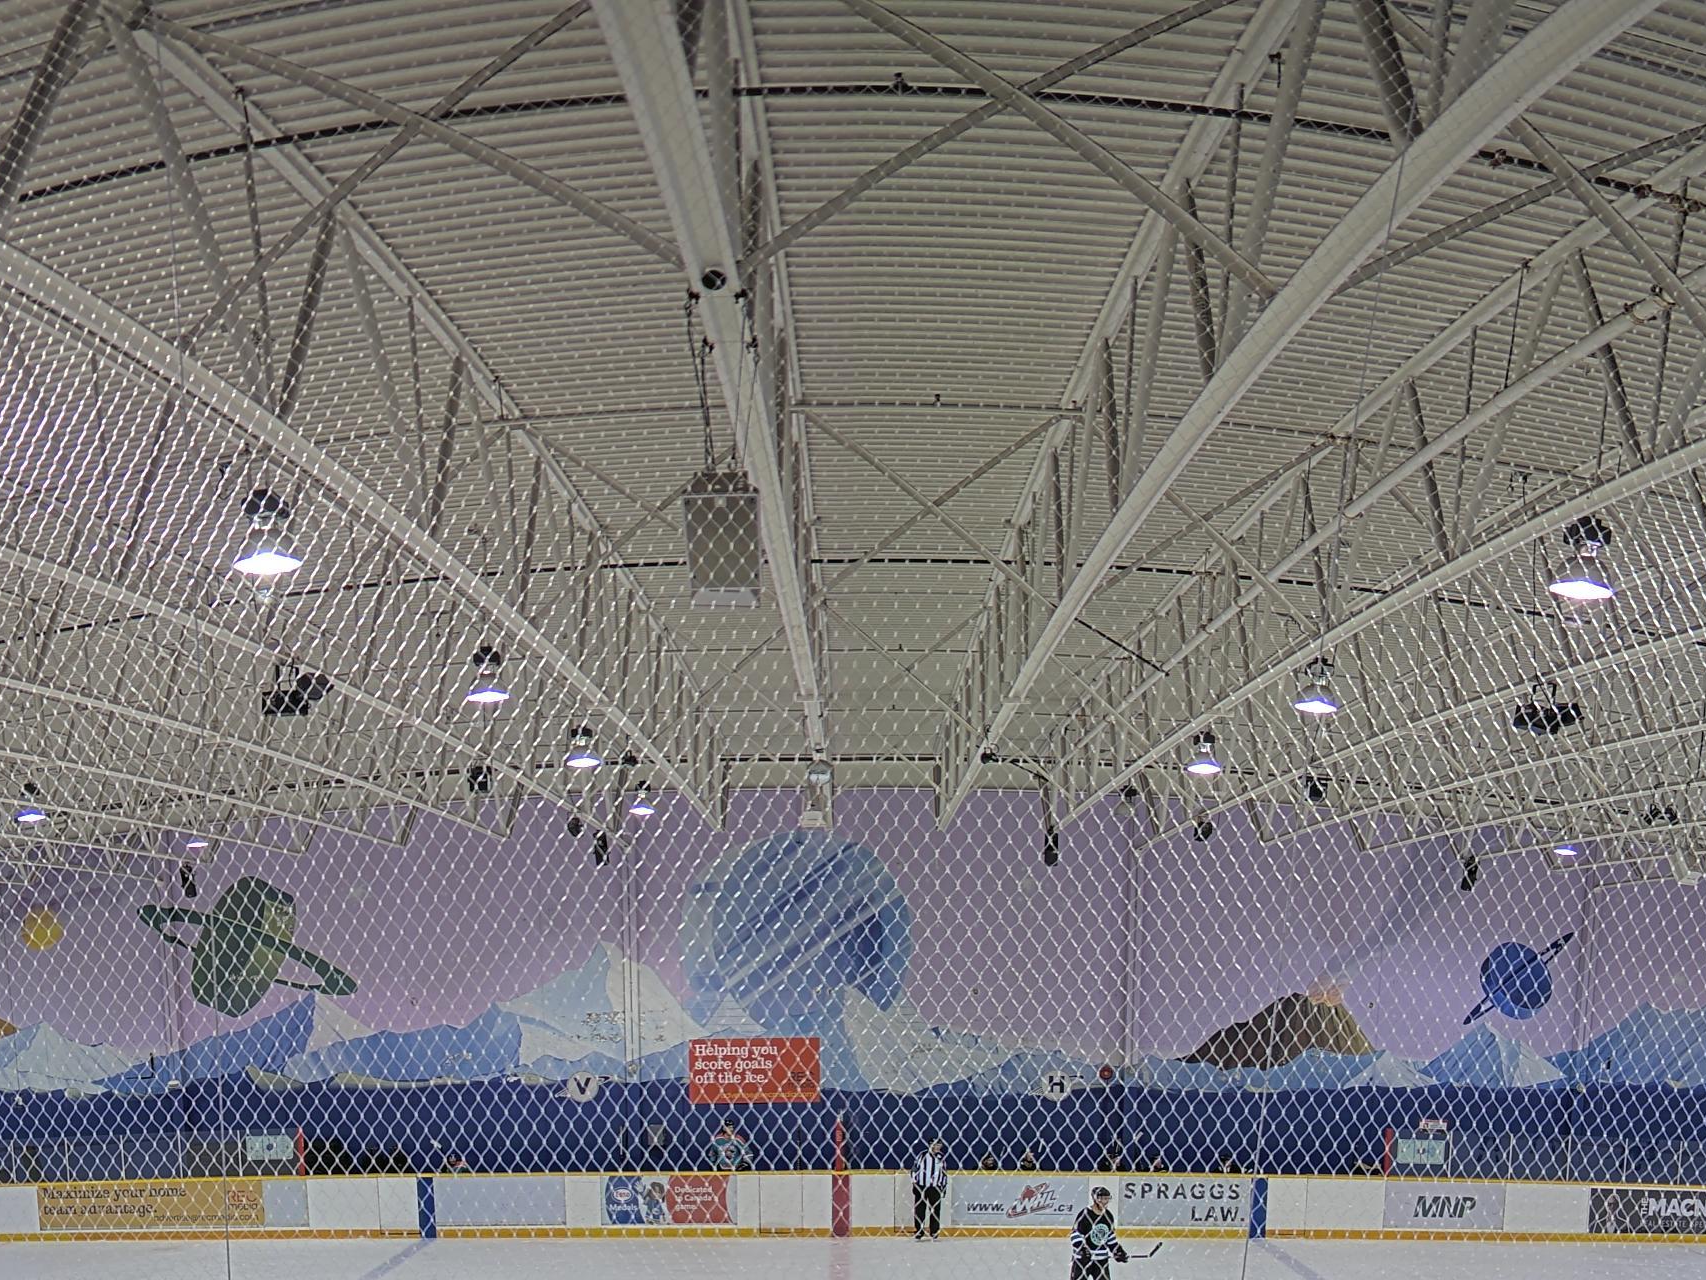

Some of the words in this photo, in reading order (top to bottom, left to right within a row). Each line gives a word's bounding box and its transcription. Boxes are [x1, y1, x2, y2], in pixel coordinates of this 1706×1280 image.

[694, 1044, 749, 1058] Helping
[752, 1046, 778, 1057] you
[695, 1060, 731, 1070] score
[735, 1059, 773, 1072] goals
[695, 1072, 716, 1083] off
[718, 1072, 741, 1083] the
[745, 1072, 769, 1083] ice.
[1049, 1076, 1065, 1093] H
[574, 1077, 591, 1095] V
[43, 1187, 110, 1200] Maximize
[113, 1188, 145, 1201] your
[149, 1186, 187, 1198] home
[1124, 1182, 1240, 1200] SPRAGGS
[44, 1205, 77, 1215] team
[1191, 1206, 1245, 1222] LAW.
[1413, 1195, 1477, 1218] MNP
